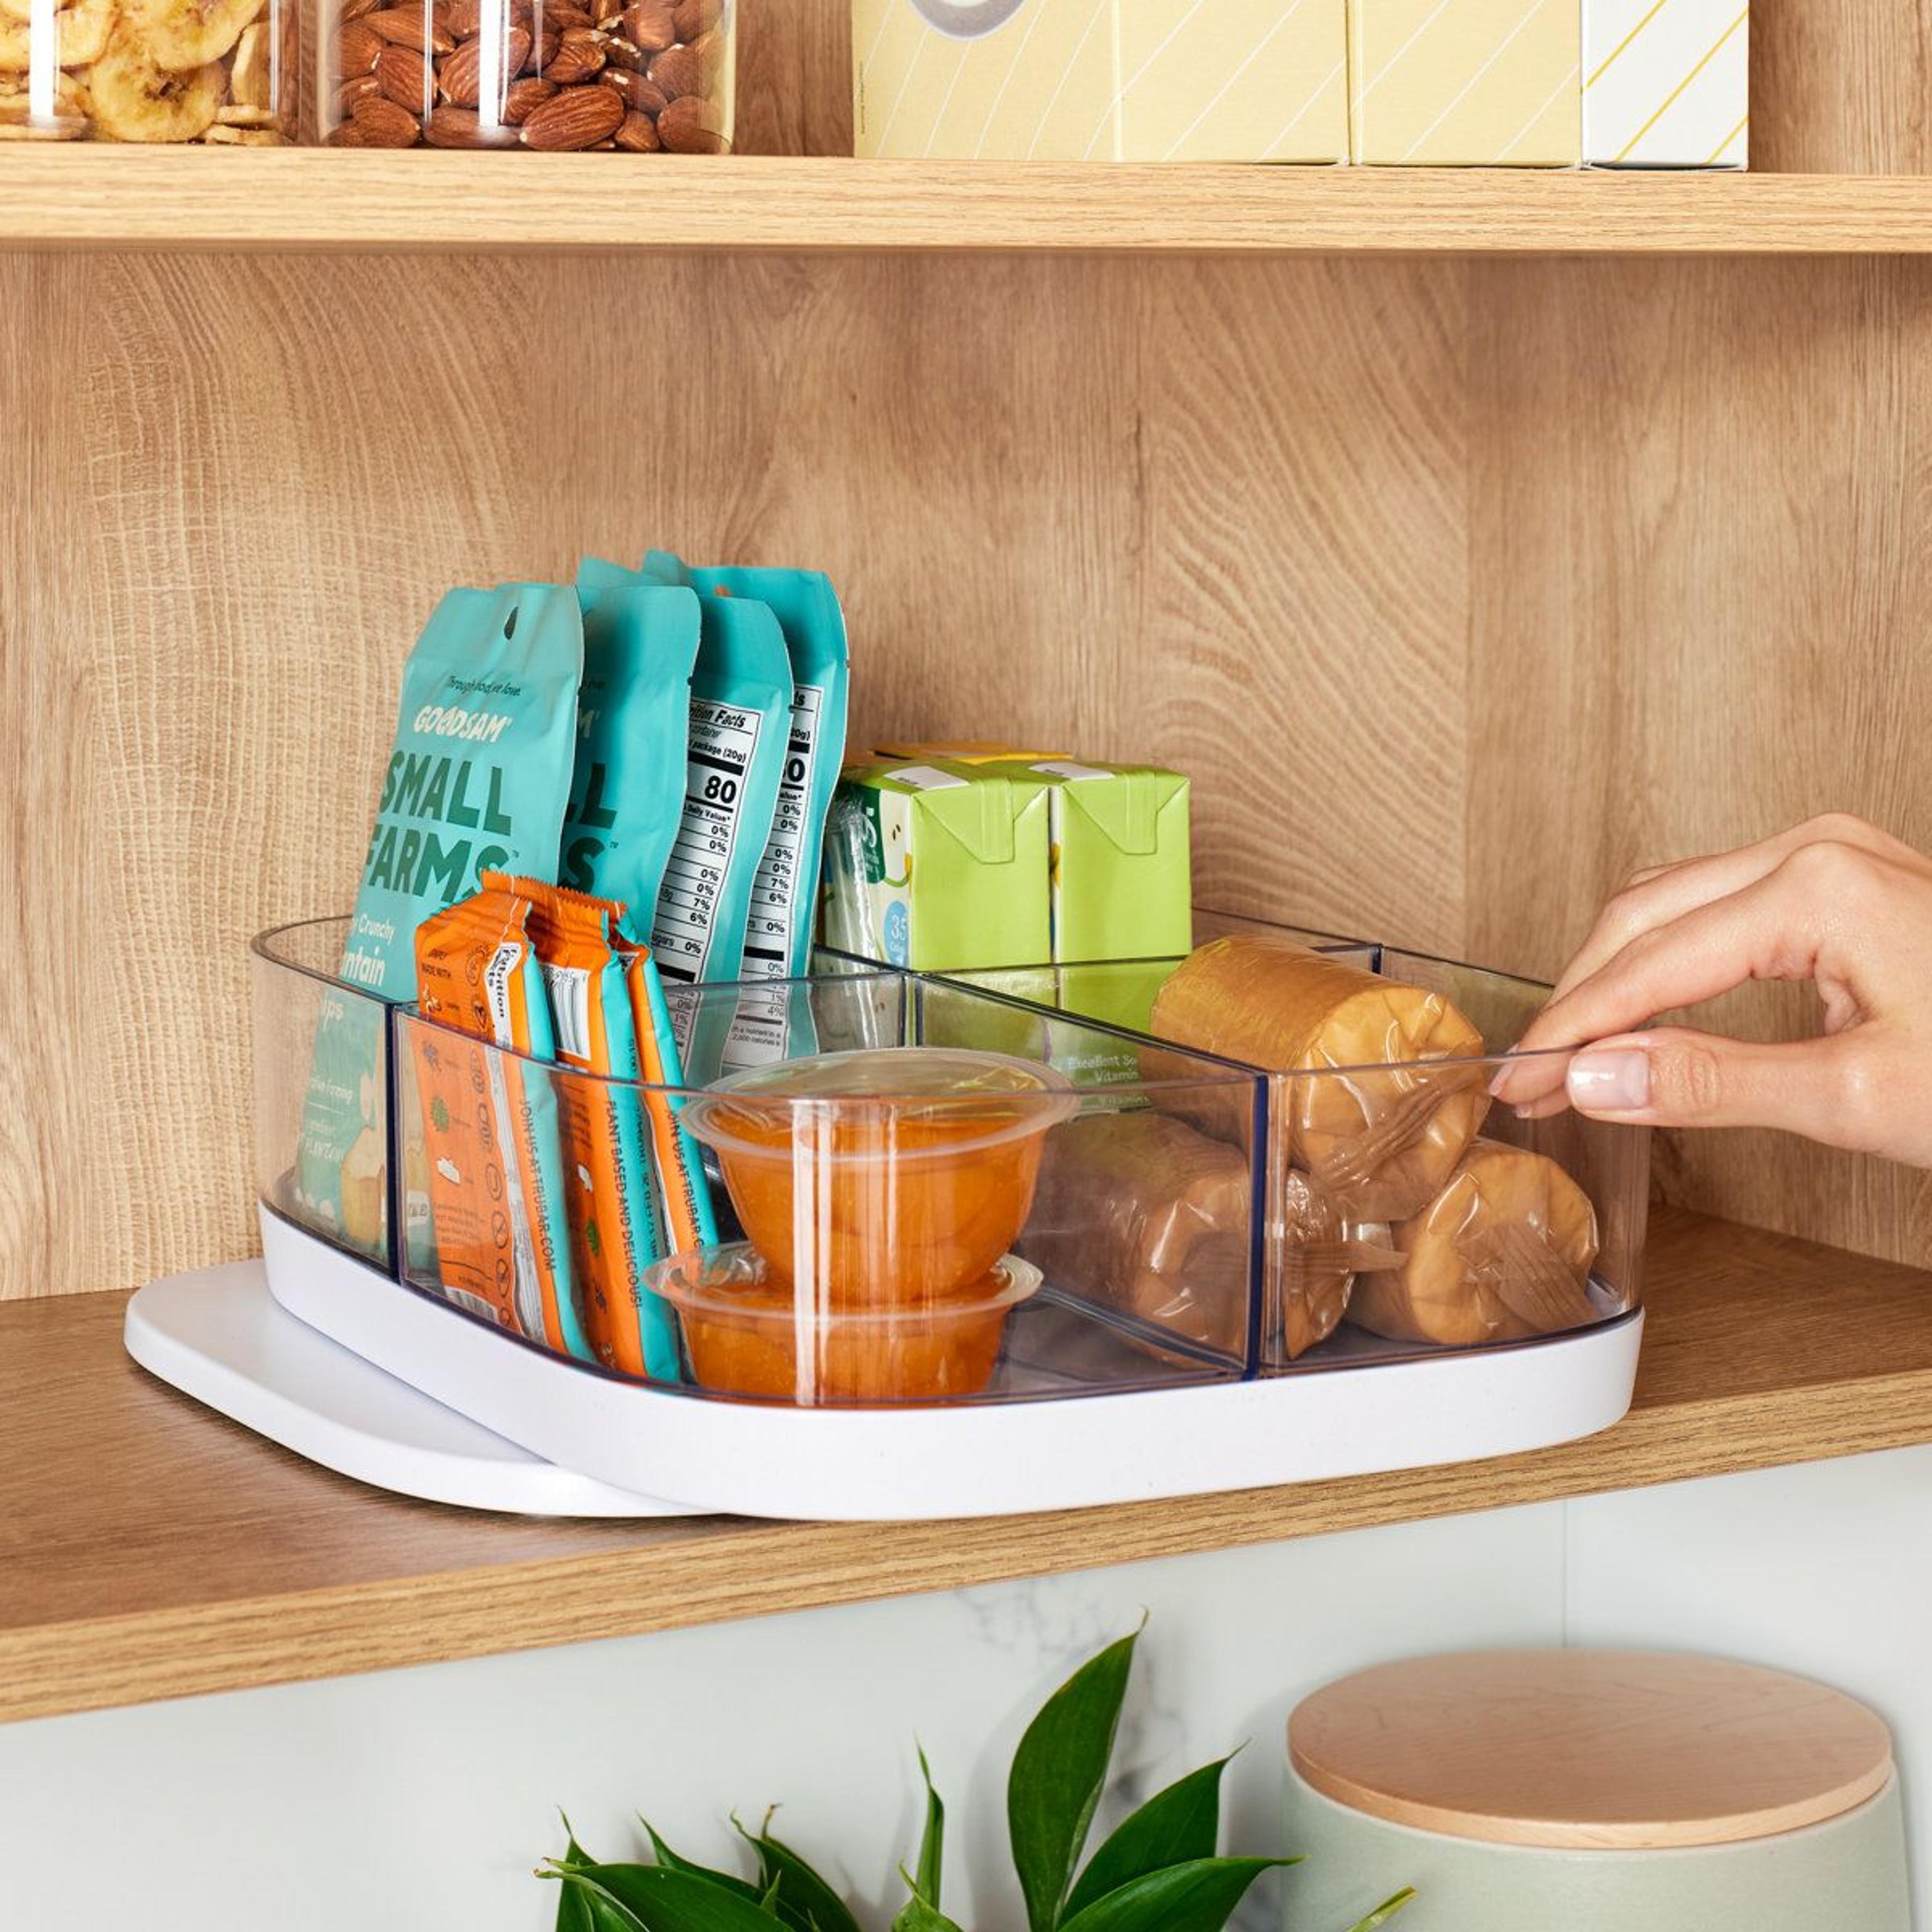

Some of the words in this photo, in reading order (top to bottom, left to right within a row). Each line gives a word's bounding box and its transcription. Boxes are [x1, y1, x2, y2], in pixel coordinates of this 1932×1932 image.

[413, 705, 509, 743] GOODSAM
[714, 710, 746, 728] Facts
[722, 747, 747, 764] (20g)
[783, 758, 805, 782] 0
[379, 750, 512, 837] SMALL
[705, 775, 736, 803] 80
[783, 804, 800, 816] 0%
[711, 826, 728, 837] 0%
[780, 819, 798, 831] 0%
[709, 840, 726, 852] 0%
[775, 848, 792, 860] 0%
[701, 869, 718, 881] 0%
[772, 863, 790, 874] 0%
[697, 883, 713, 896] 0%
[771, 877, 788, 889] 7%
[694, 898, 710, 910] 7%
[769, 893, 786, 904] 6%
[690, 913, 707, 925] 6%
[767, 922, 784, 932] 0%
[685, 942, 701, 953] 0%
[341, 945, 386, 986] ntain
[768, 962, 784, 973] 0%
[520, 1101, 534, 1136] JOIN
[606, 1101, 621, 1144] PLANT
[524, 1136, 538, 1154] US
[672, 1141, 687, 1160] US
[528, 1158, 542, 1175] AT
[612, 1148, 627, 1192] BASED
[676, 1162, 690, 1179] AT
[617, 1196, 632, 1226] AND
[682, 1180, 704, 1248] TRUBAR.C
[533, 1178, 555, 1270] TRUBAR.COM
[622, 1231, 642, 1308] DELICIOUS!
